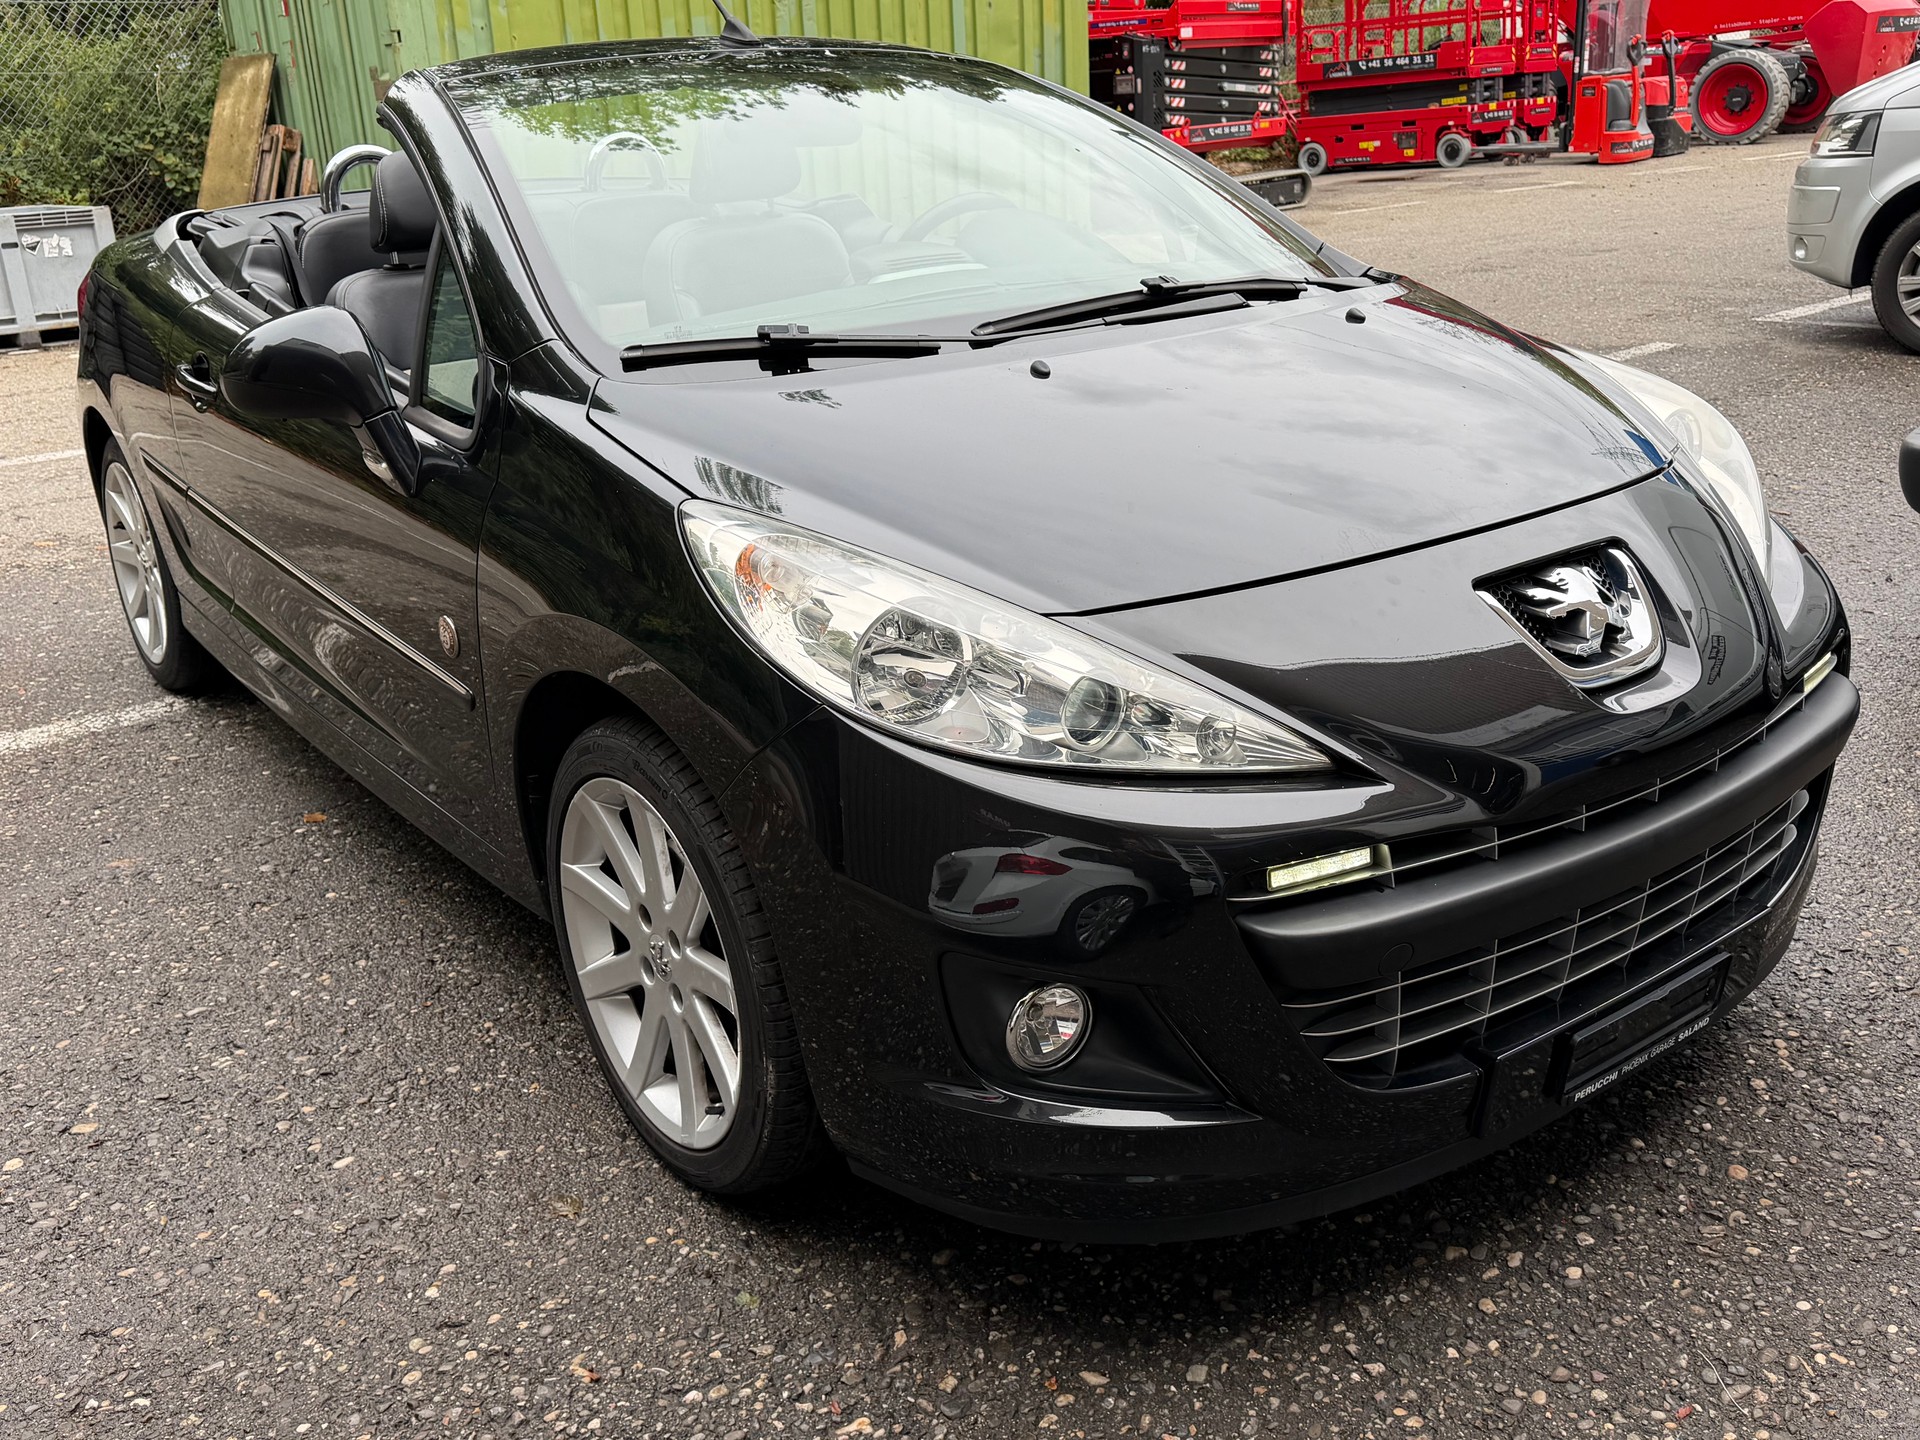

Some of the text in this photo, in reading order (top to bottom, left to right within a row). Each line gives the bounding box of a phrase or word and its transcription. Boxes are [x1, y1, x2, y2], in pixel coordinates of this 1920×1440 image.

[1368, 59, 1381, 69] +41
[1383, 58, 1394, 67] 56
[1395, 56, 1410, 66] 464
[1412, 55, 1422, 64] 31
[1425, 54, 1435, 63] 31
[1574, 1017, 1710, 1102] PERUCCHI PHOENIX GARAGE SALAND
